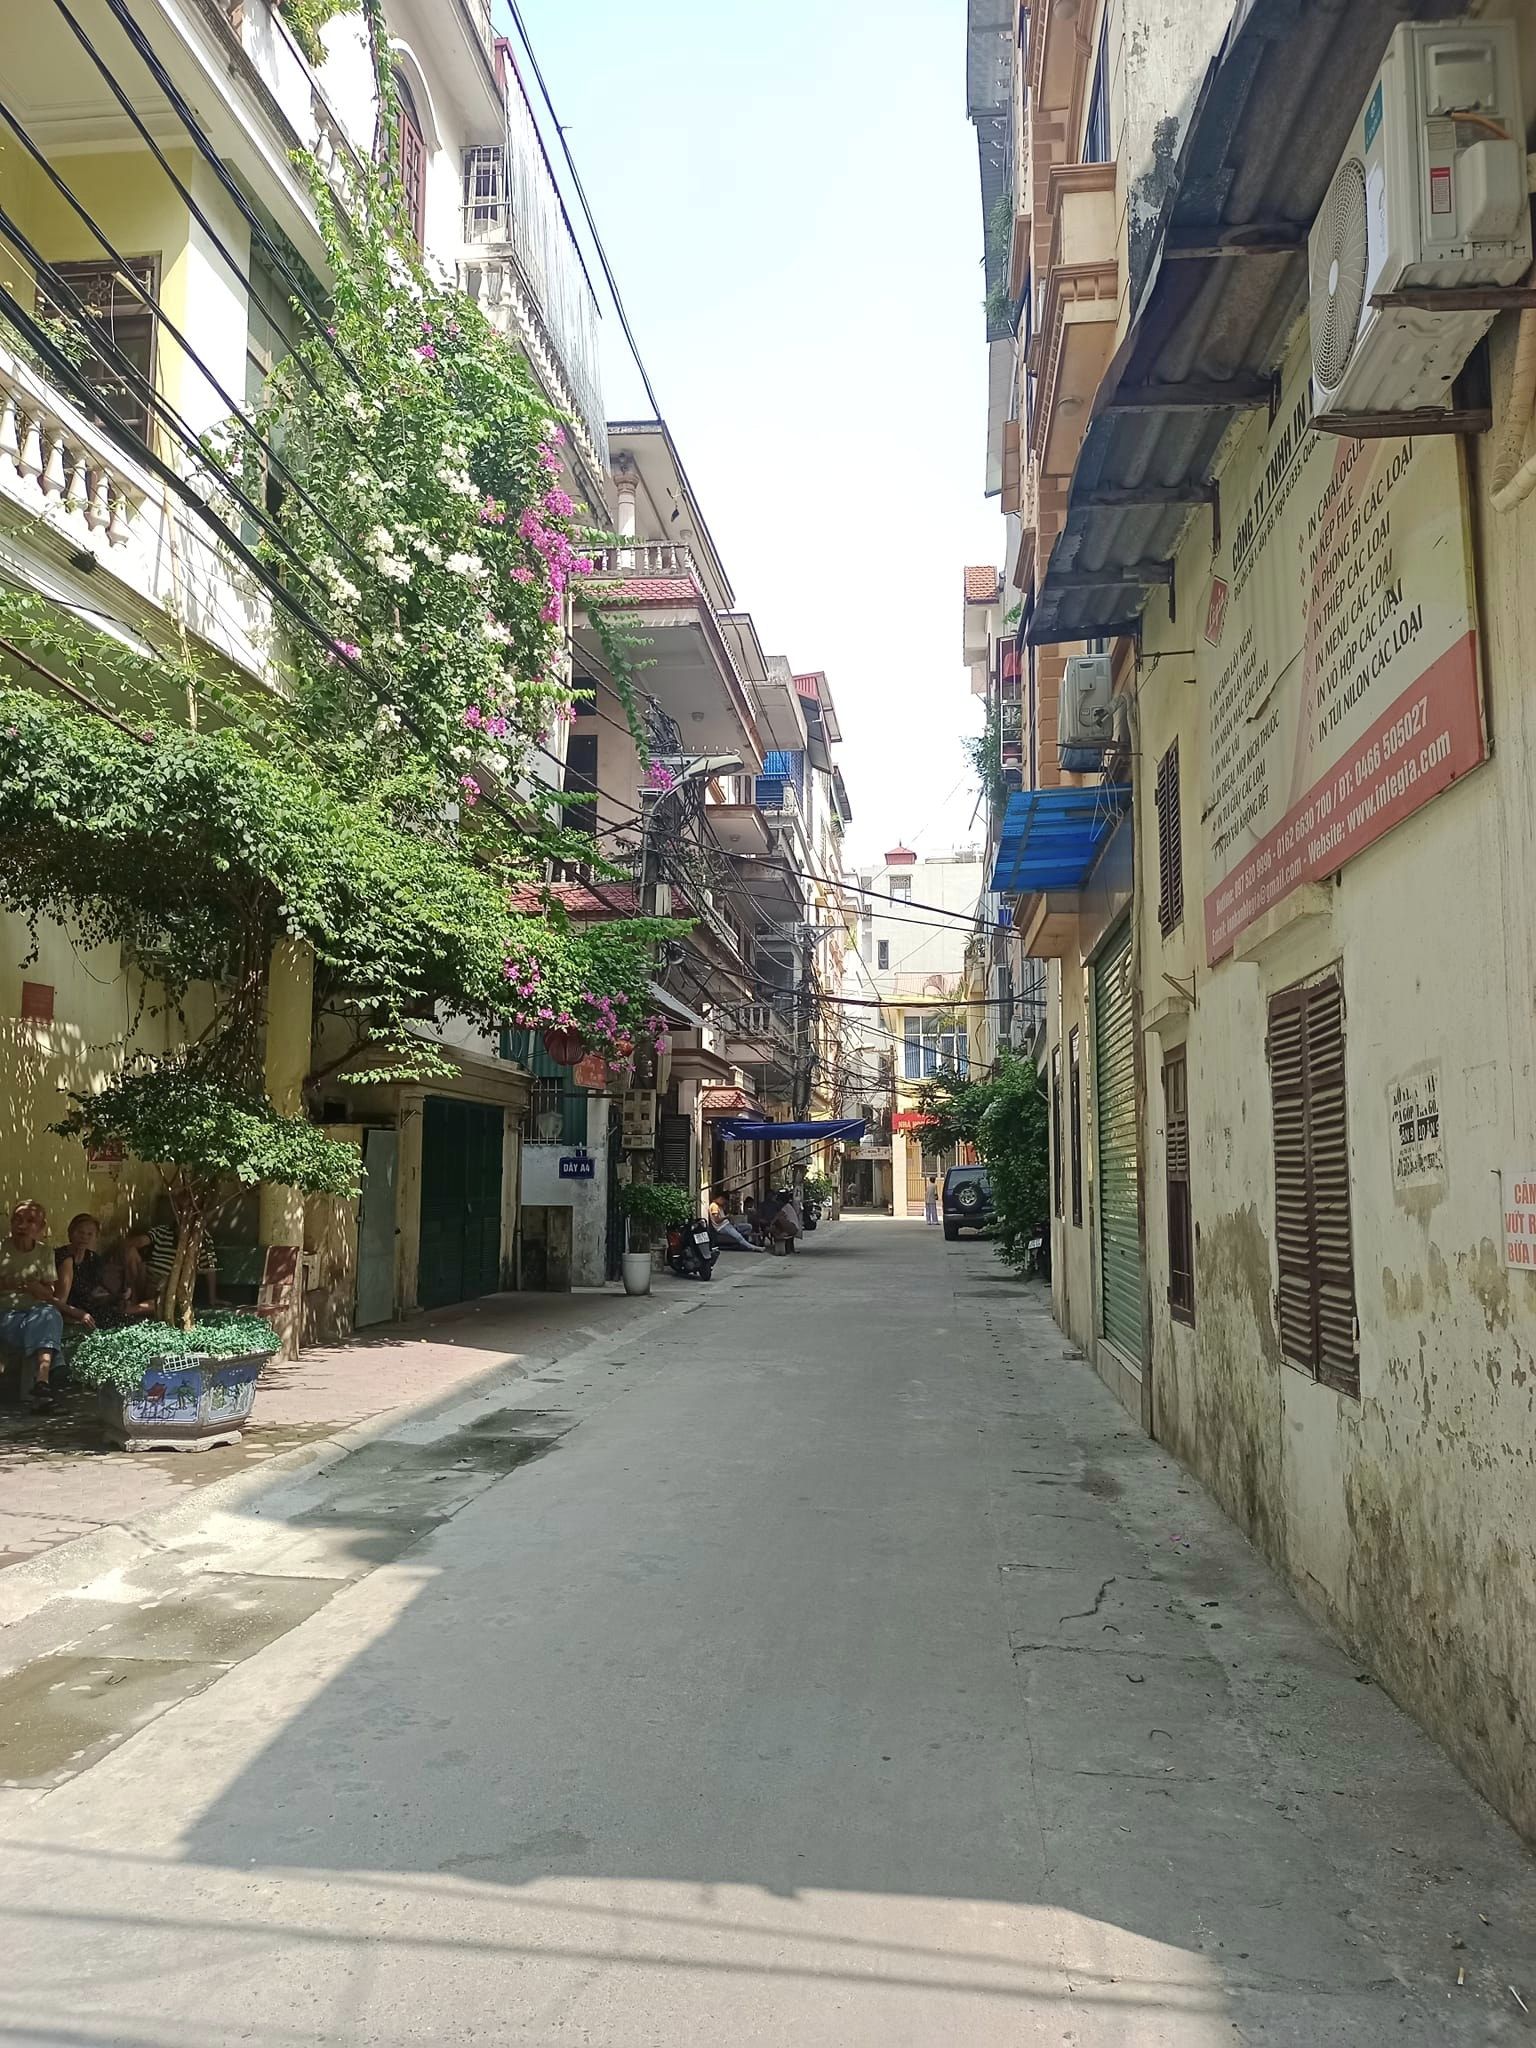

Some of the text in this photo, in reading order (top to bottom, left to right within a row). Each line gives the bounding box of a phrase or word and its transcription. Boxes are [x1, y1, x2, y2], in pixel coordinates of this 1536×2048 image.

[1233, 392, 1306, 572] CÔNG TY TNHH IN
[1308, 438, 1364, 540] IN CATALOGUE
[1310, 486, 1353, 573] IN KẸP FILE
[1312, 436, 1412, 606] IN PHONG BÌ CÁC LOẠI
[1314, 510, 1390, 640] IN THIỆP CÁC LOẠI
[1316, 548, 1392, 674] IN MENU CÁC LOẠI
[1240, 624, 1252, 658] NGAY
[1244, 648, 1256, 679] NGAY
[1256, 660, 1268, 692] LOẠI
[1317, 683, 1325, 708] IN
[1340, 641, 1357, 680] HỘP
[1360, 612, 1377, 653] CÁC
[1379, 578, 1402, 627] LOẠI
[1319, 604, 1422, 742] IN TÚI NILON CÁC LOẠI
[1242, 775, 1252, 800] CÁC
[1253, 759, 1265, 787] LOẠI
[1245, 864, 1255, 888] 520
[1277, 826, 1294, 859] 0162
[1296, 807, 1314, 842] 6630
[1316, 790, 1331, 823] 700
[1339, 770, 1352, 802] ĐT:
[1355, 742, 1380, 786] 0466
[1383, 696, 1427, 760] 505027
[1308, 821, 1344, 865] Website:
[1347, 730, 1450, 833] www.inlegia.com
[580, 1163, 590, 1172] A4
